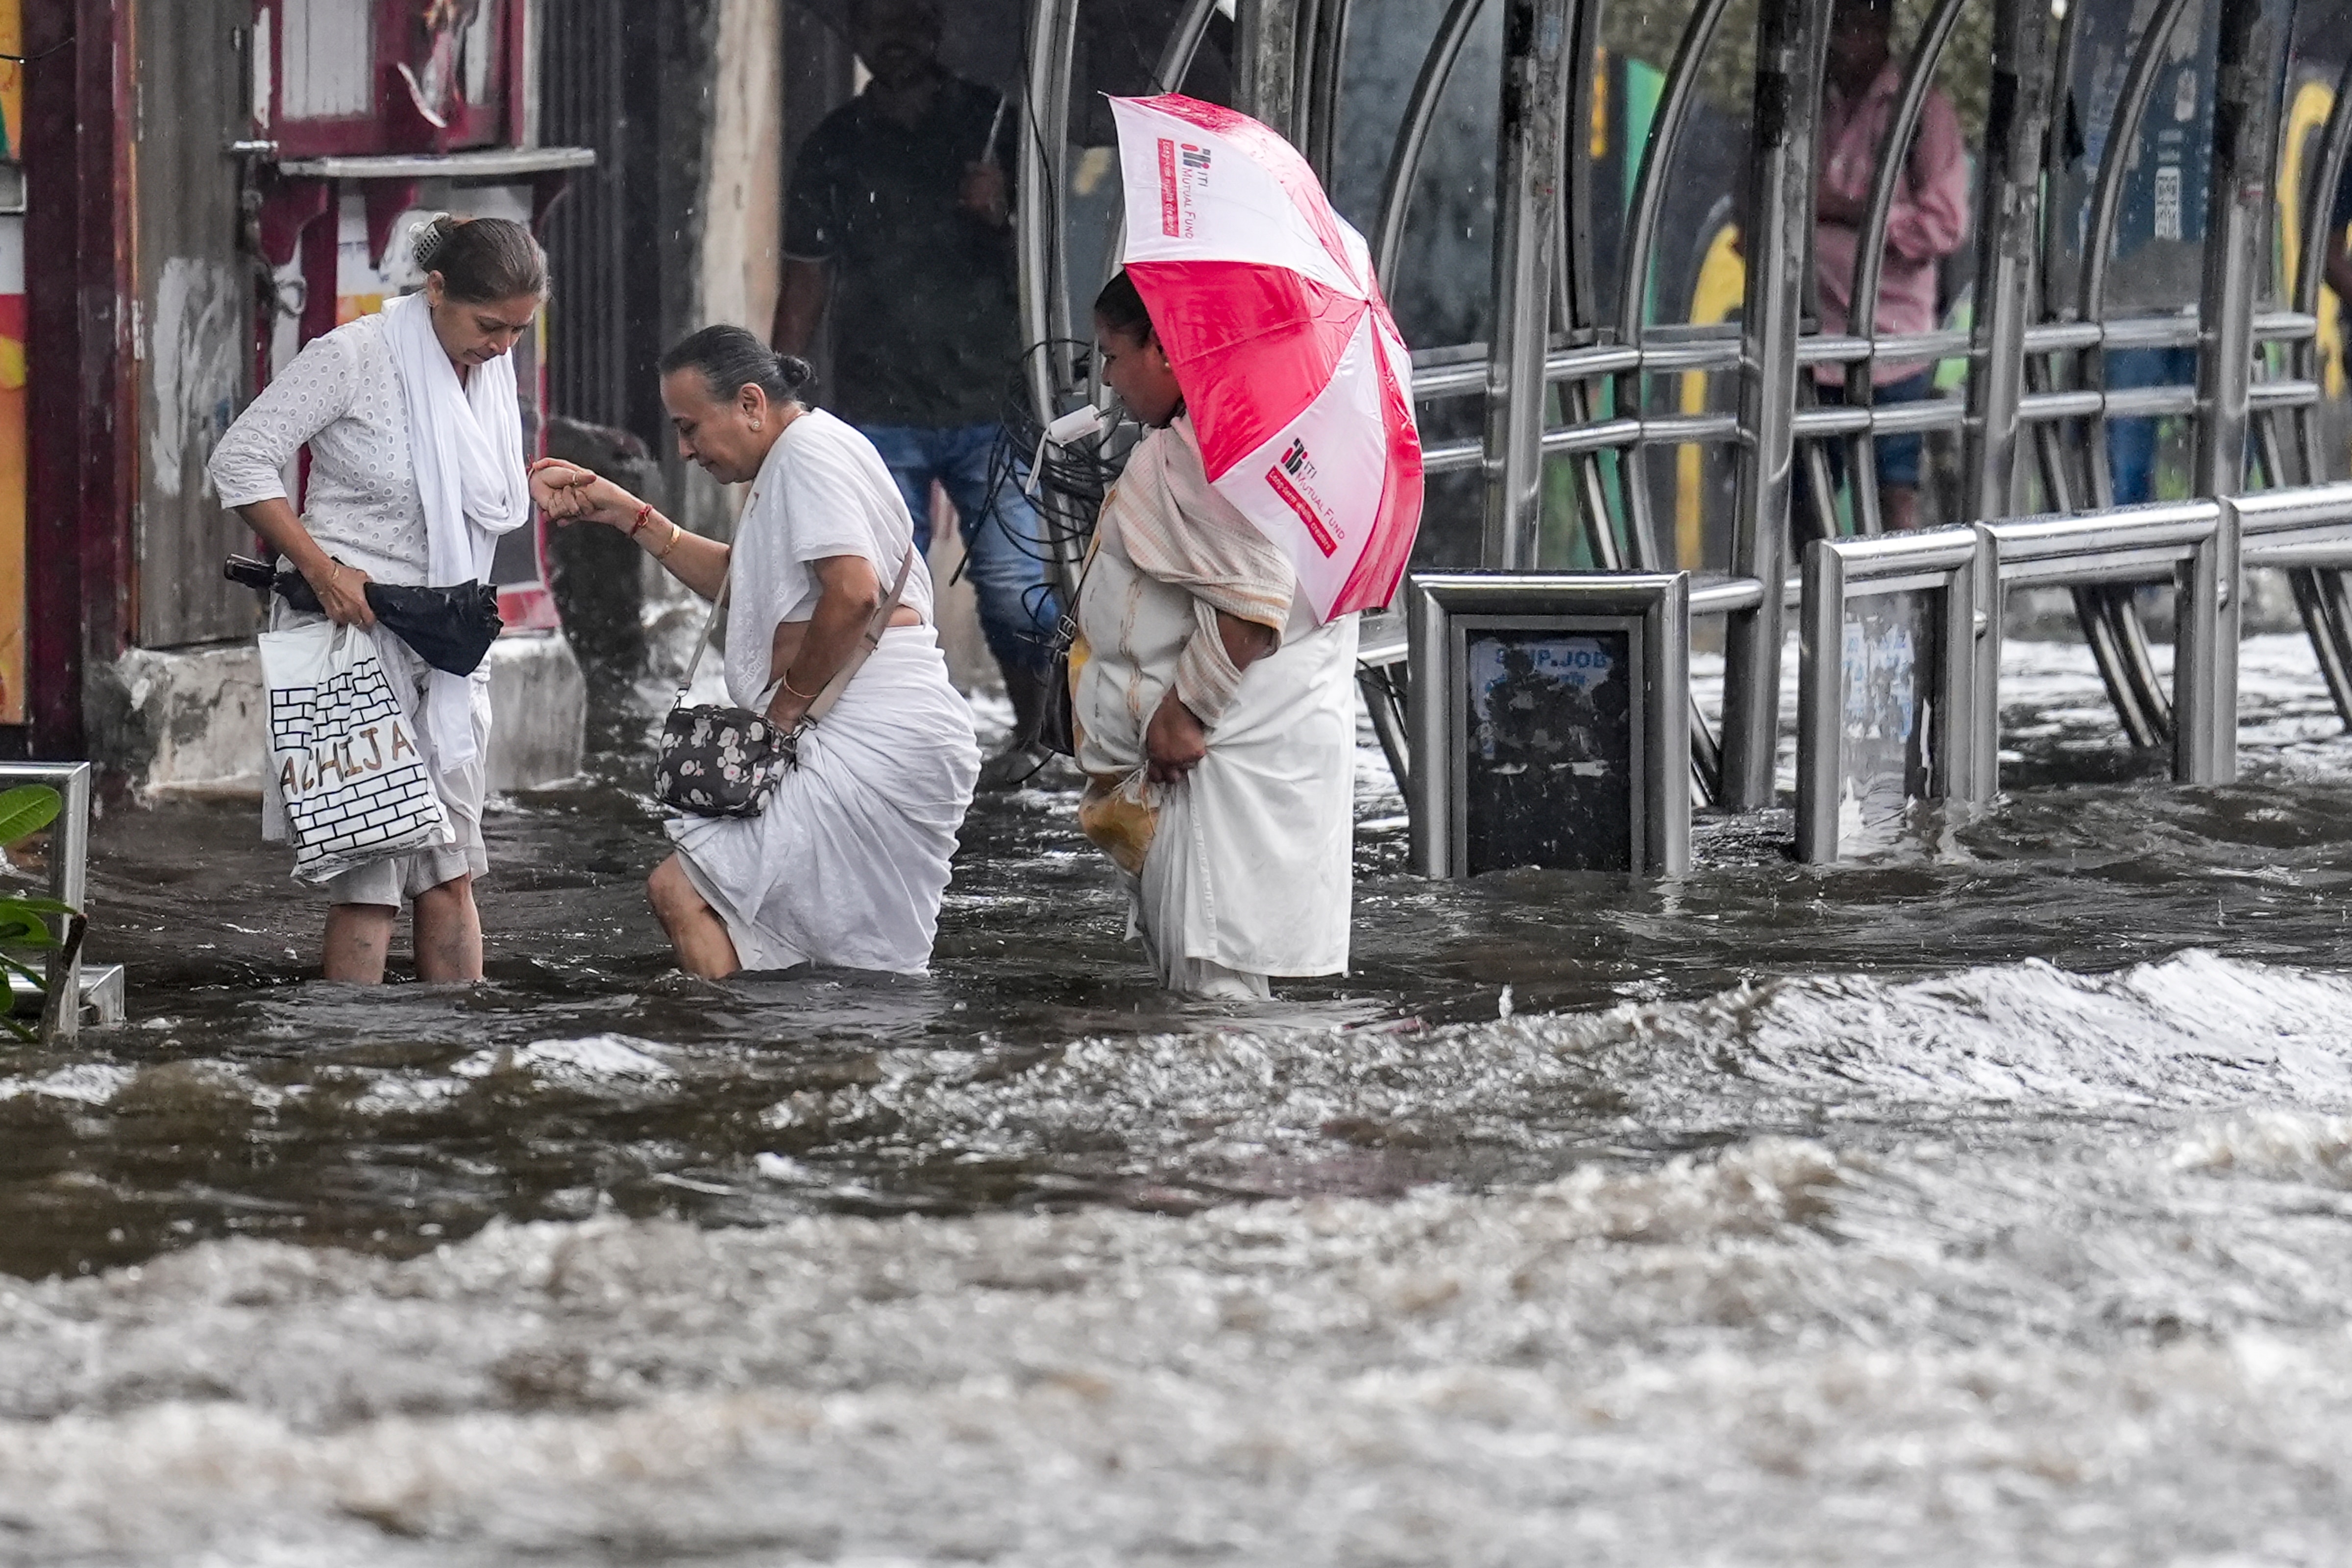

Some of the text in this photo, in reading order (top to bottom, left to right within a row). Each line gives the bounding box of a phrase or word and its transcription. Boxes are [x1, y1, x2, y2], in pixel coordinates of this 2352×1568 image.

[1197, 171, 1208, 188] ITI
[1181, 167, 1196, 239] MUTUAL FUND
[1303, 460, 1317, 479] ITI
[1295, 472, 1345, 540] MUTUAL FUND
